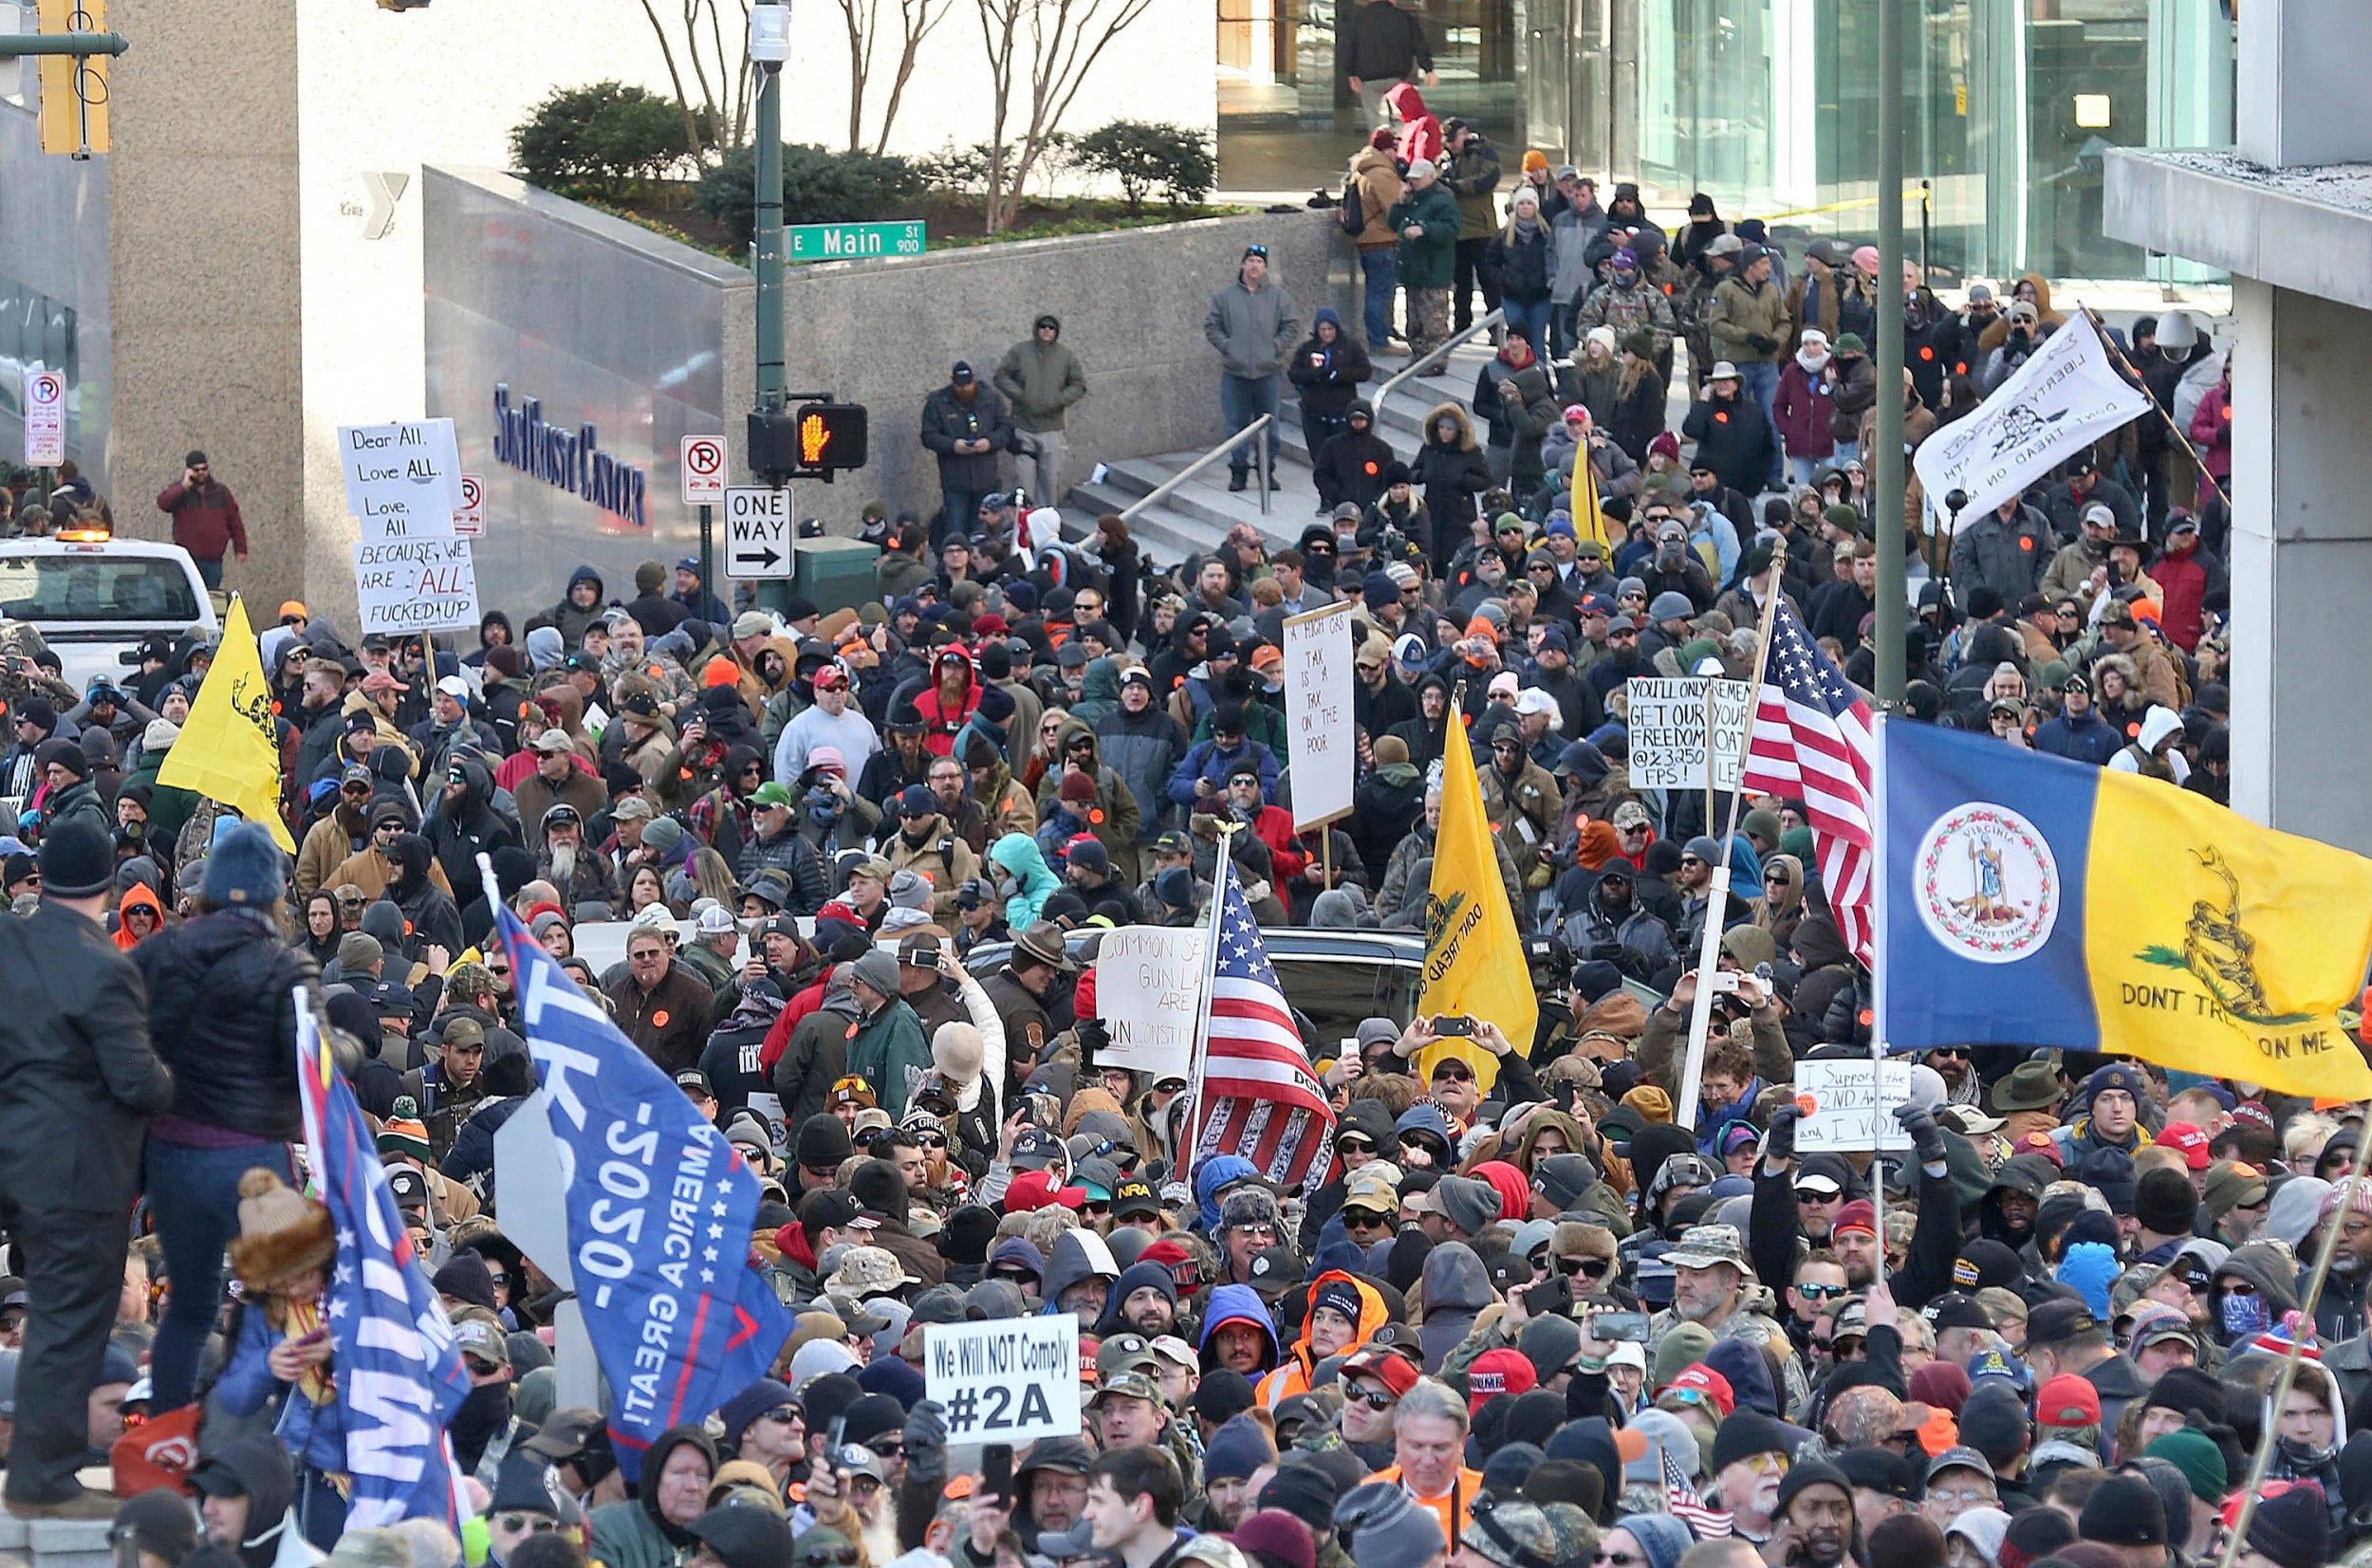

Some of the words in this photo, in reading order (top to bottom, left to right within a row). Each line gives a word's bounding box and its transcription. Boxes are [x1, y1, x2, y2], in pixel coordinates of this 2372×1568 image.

[795, 235, 804, 250] E
[824, 228, 881, 254] Main
[905, 225, 918, 238] St
[897, 239, 919, 252] 900
[352, 430, 392, 450] Dear
[358, 463, 398, 481] Love
[364, 497, 410, 517] Love,
[733, 495, 784, 515] ONE
[733, 522, 785, 541] WAY
[443, 540, 470, 558] WE
[361, 571, 395, 590] ARE
[418, 566, 464, 595] ALL
[370, 601, 435, 623] FUCKED
[444, 600, 471, 618] UP
[1290, 624, 1298, 641] A
[1305, 618, 1325, 639] HIGH
[1329, 614, 1344, 636] GAS
[1306, 648, 1325, 668] TAX
[1301, 671, 1310, 688] IS
[1322, 667, 1328, 682] A
[1630, 679, 1677, 699] YOU'LL
[1680, 680, 1708, 700] ONLY
[1306, 691, 1322, 710] TAX
[1302, 715, 1313, 732] ON
[1321, 706, 1338, 727] THE
[1631, 705, 1667, 726] GET
[1673, 704, 1705, 727] OUR
[1307, 734, 1328, 755] POOR
[1631, 729, 1706, 747] FREEDOM
[1102, 933, 1174, 959] COMMON
[1139, 963, 1174, 988] GUN
[1158, 991, 1191, 1012] ARE
[2122, 983, 2186, 1011] DONT
[2258, 1037, 2291, 1060] ON
[2302, 1030, 2335, 1055] ME
[1884, 1070, 1905, 1083] the
[1820, 1090, 1857, 1110] 2ND
[1800, 1126, 1824, 1138] and
[1119, 1183, 1152, 1200] NRA
[935, 1338, 955, 1378] We
[959, 1336, 984, 1376] Will
[989, 1333, 1015, 1374] NOT
[1021, 1329, 1070, 1380] Comply
[948, 1382, 1054, 1434] #2A
